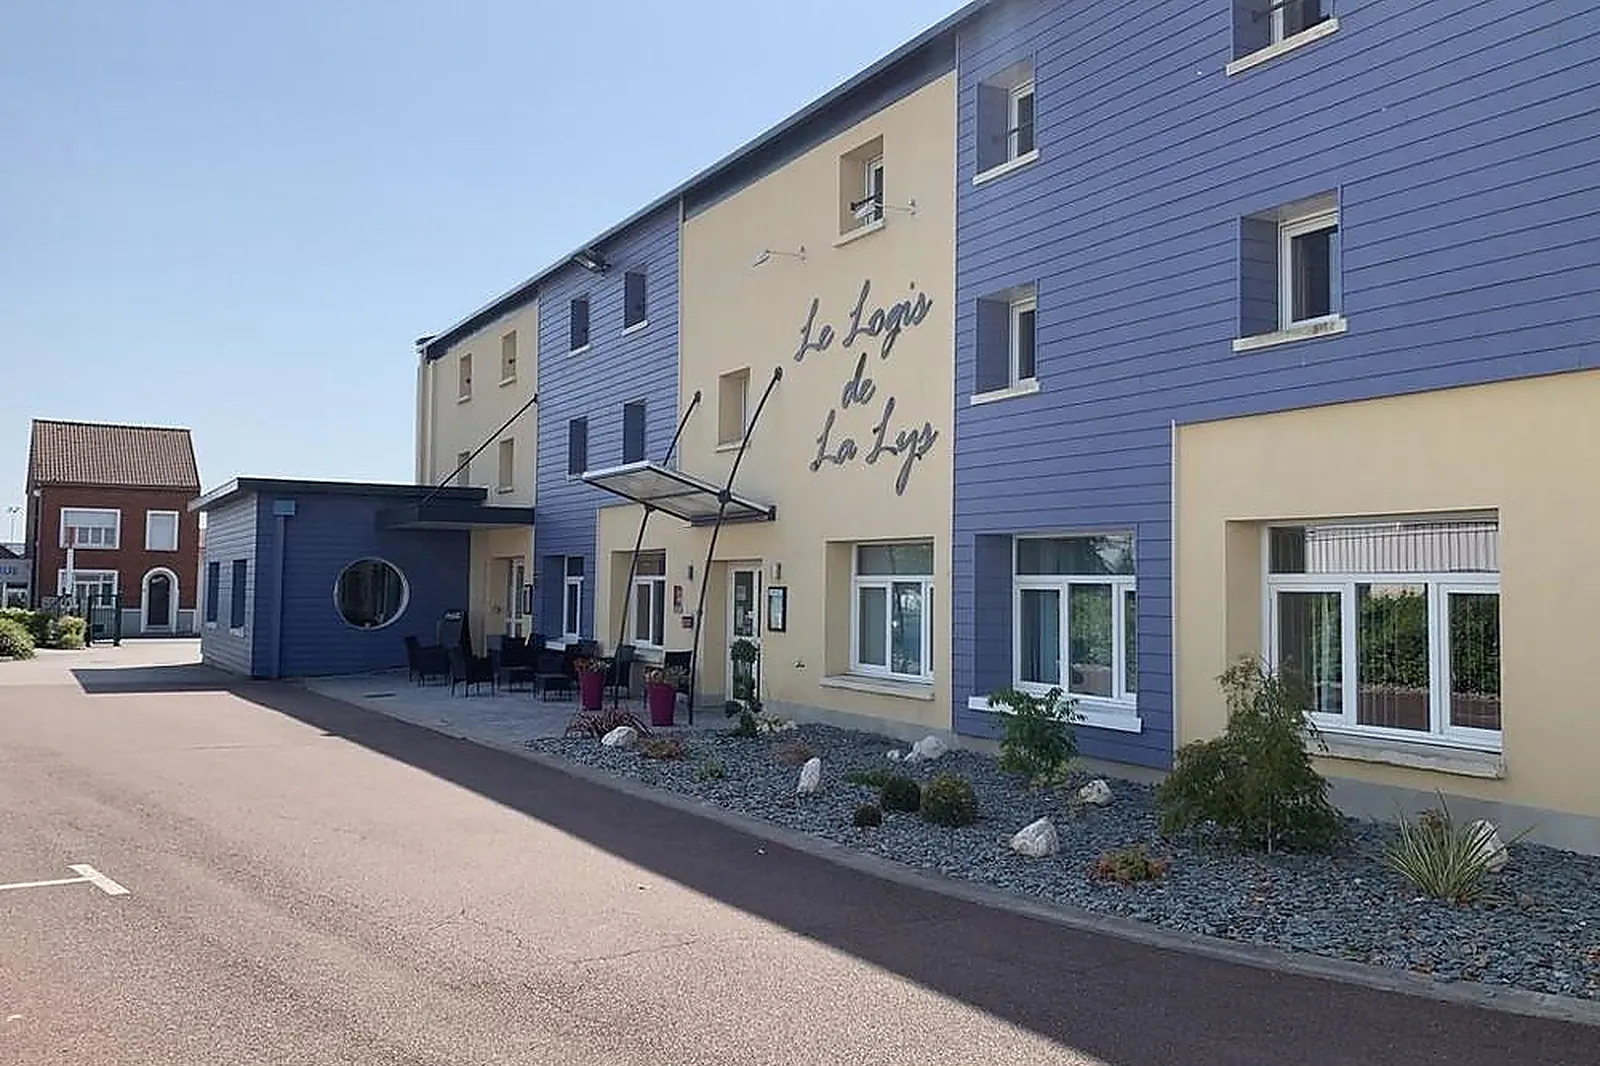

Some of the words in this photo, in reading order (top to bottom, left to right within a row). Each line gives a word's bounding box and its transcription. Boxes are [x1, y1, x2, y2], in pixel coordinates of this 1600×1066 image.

[794, 298, 835, 362] Le
[842, 280, 932, 360] Logis
[842, 352, 876, 409] de
[809, 409, 857, 472] La
[865, 397, 939, 496] Lys
